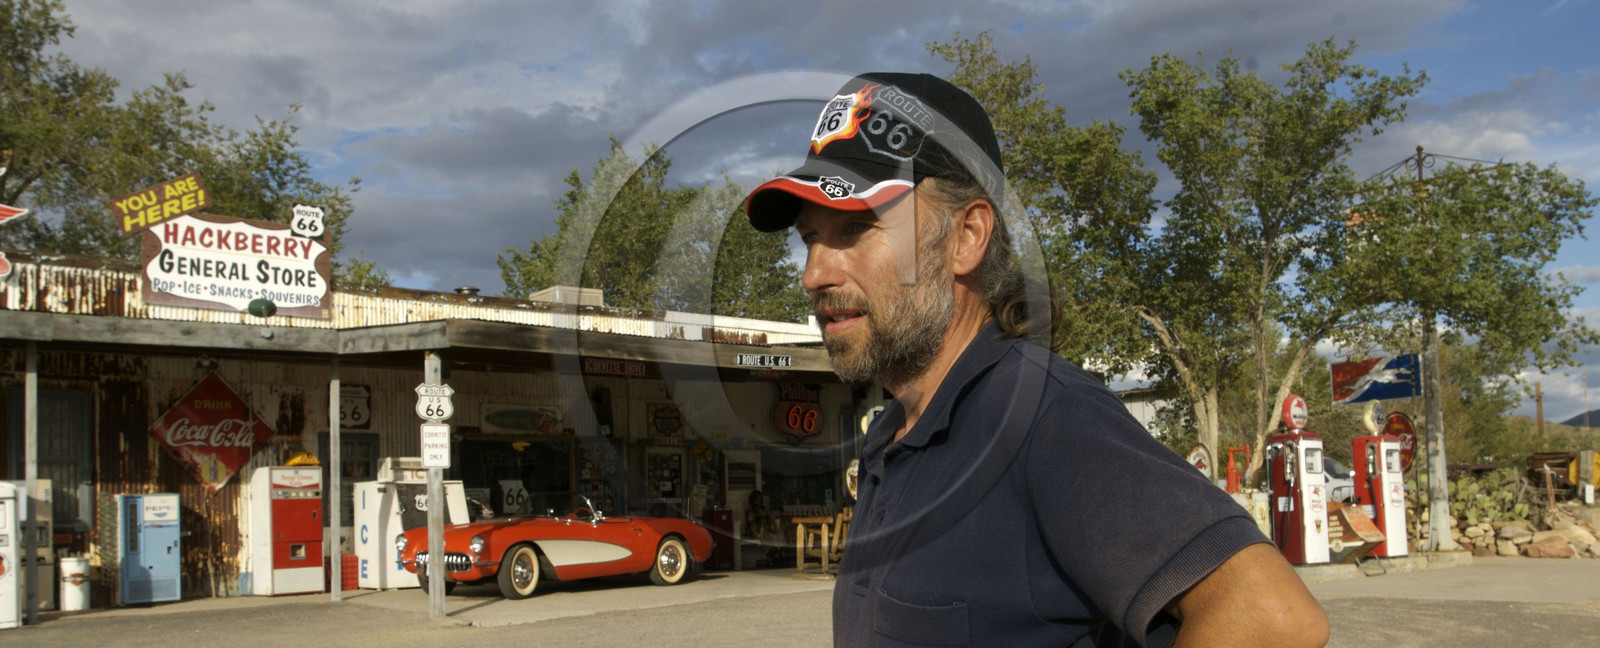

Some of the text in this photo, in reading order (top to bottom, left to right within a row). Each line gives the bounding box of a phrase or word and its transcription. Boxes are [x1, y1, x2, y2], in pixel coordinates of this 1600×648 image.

[884, 90, 932, 127] ROUTE
[817, 112, 843, 136] 66
[867, 110, 913, 150] 66
[115, 176, 199, 214] YOU ARE
[824, 178, 849, 189] ROUTE
[825, 184, 844, 197] 66
[123, 189, 206, 232] HERE!
[296, 209, 321, 219] ROUTE
[297, 218, 319, 232] 66
[164, 222, 313, 260] HACKBERRY
[159, 249, 317, 288] GENERAL STORE
[210, 284, 253, 300] SNACKS
[260, 288, 320, 307] SOUVENIRS
[743, 355, 761, 366] ROUTE
[779, 356, 787, 367] 66
[194, 399, 232, 410] DRINK
[426, 403, 444, 417] 66
[788, 405, 817, 432] 66
[167, 418, 258, 448] Coca-Cola
[505, 488, 525, 506] 66
